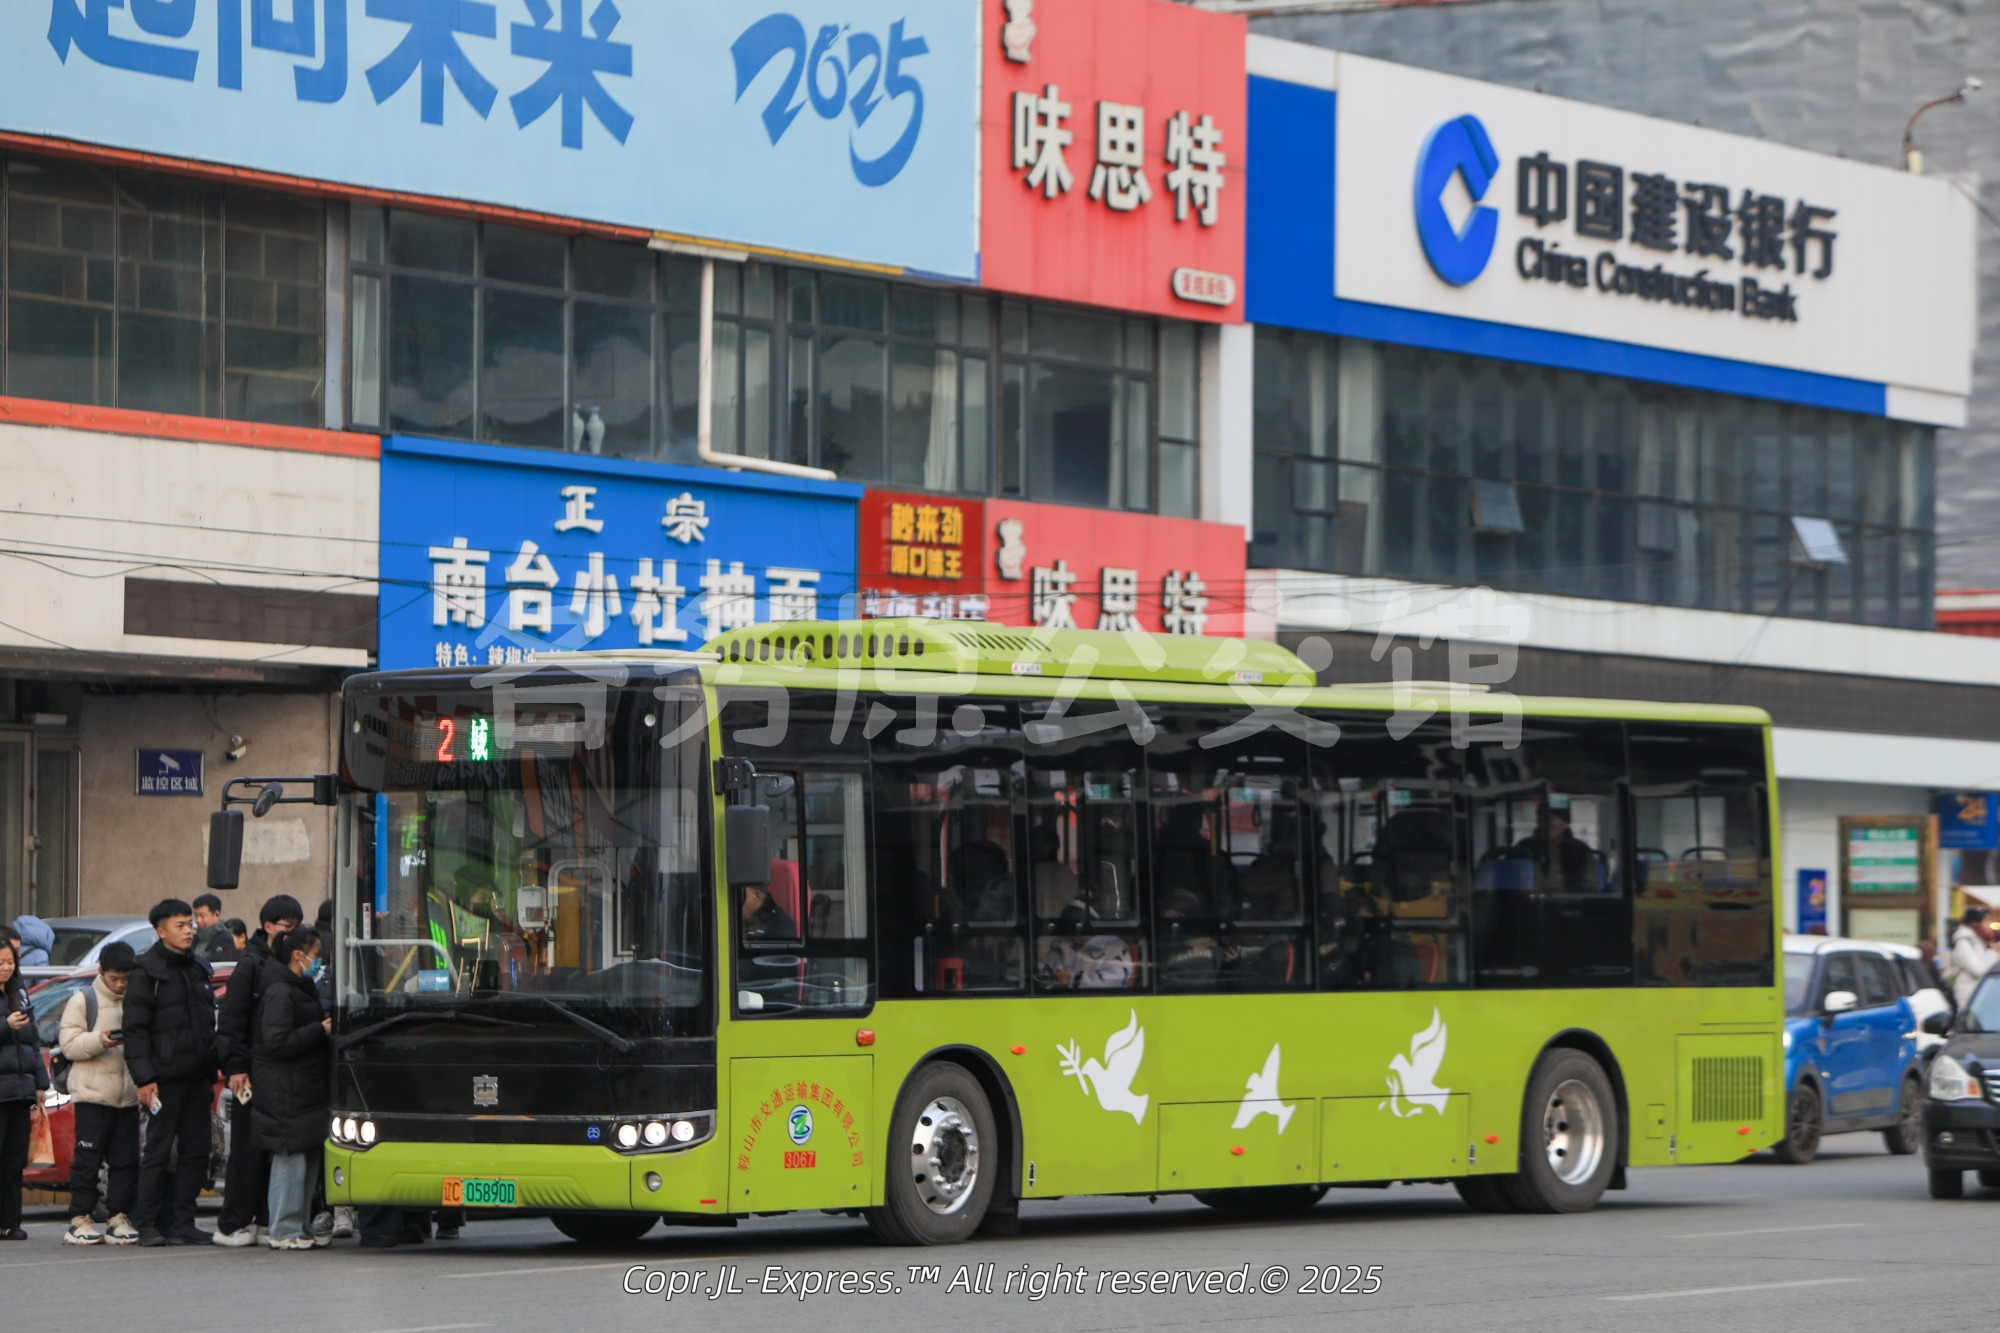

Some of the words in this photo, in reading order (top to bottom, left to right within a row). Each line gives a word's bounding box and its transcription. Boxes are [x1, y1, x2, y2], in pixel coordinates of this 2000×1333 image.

[730, 12, 930, 188] 2025
[1011, 83, 1227, 228] 味思特
[1517, 151, 1837, 279] 中国建设银行
[1516, 237, 1588, 287] China
[1740, 276, 1797, 322] Bank
[428, 537, 820, 645] 南台小杜抽面
[1030, 560, 1208, 635] 味思特
[141, 776, 199, 791] 监控区域
[438, 719, 456, 762] 2
[737, 1080, 864, 1172] 鞍山市交通运输集团有限公司
[784, 1152, 816, 1168] 3067
